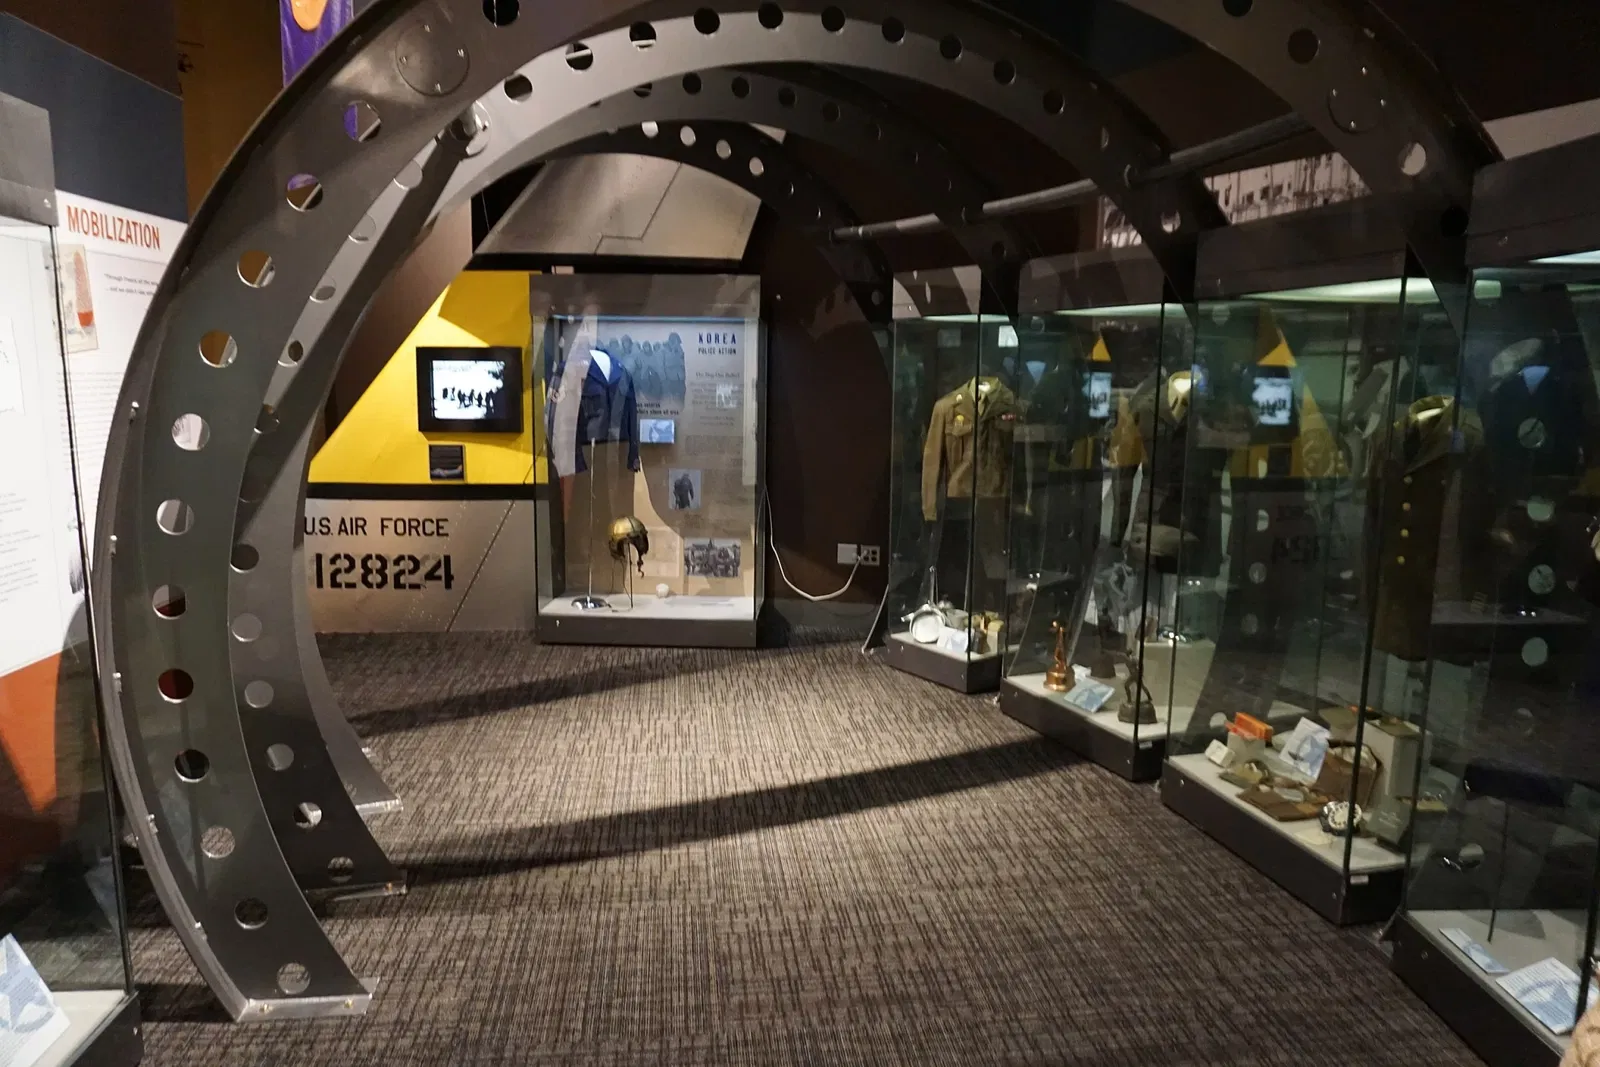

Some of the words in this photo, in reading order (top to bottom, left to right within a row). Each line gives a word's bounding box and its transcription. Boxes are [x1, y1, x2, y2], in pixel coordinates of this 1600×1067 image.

[67, 205, 161, 250] MOBILIZATION
[698, 332, 737, 345] KOREA
[698, 347, 716, 356] POLICE
[304, 516, 333, 536] U.S.
[338, 516, 367, 536] AIR
[380, 517, 449, 537] FORCE
[315, 553, 454, 589] 12824
